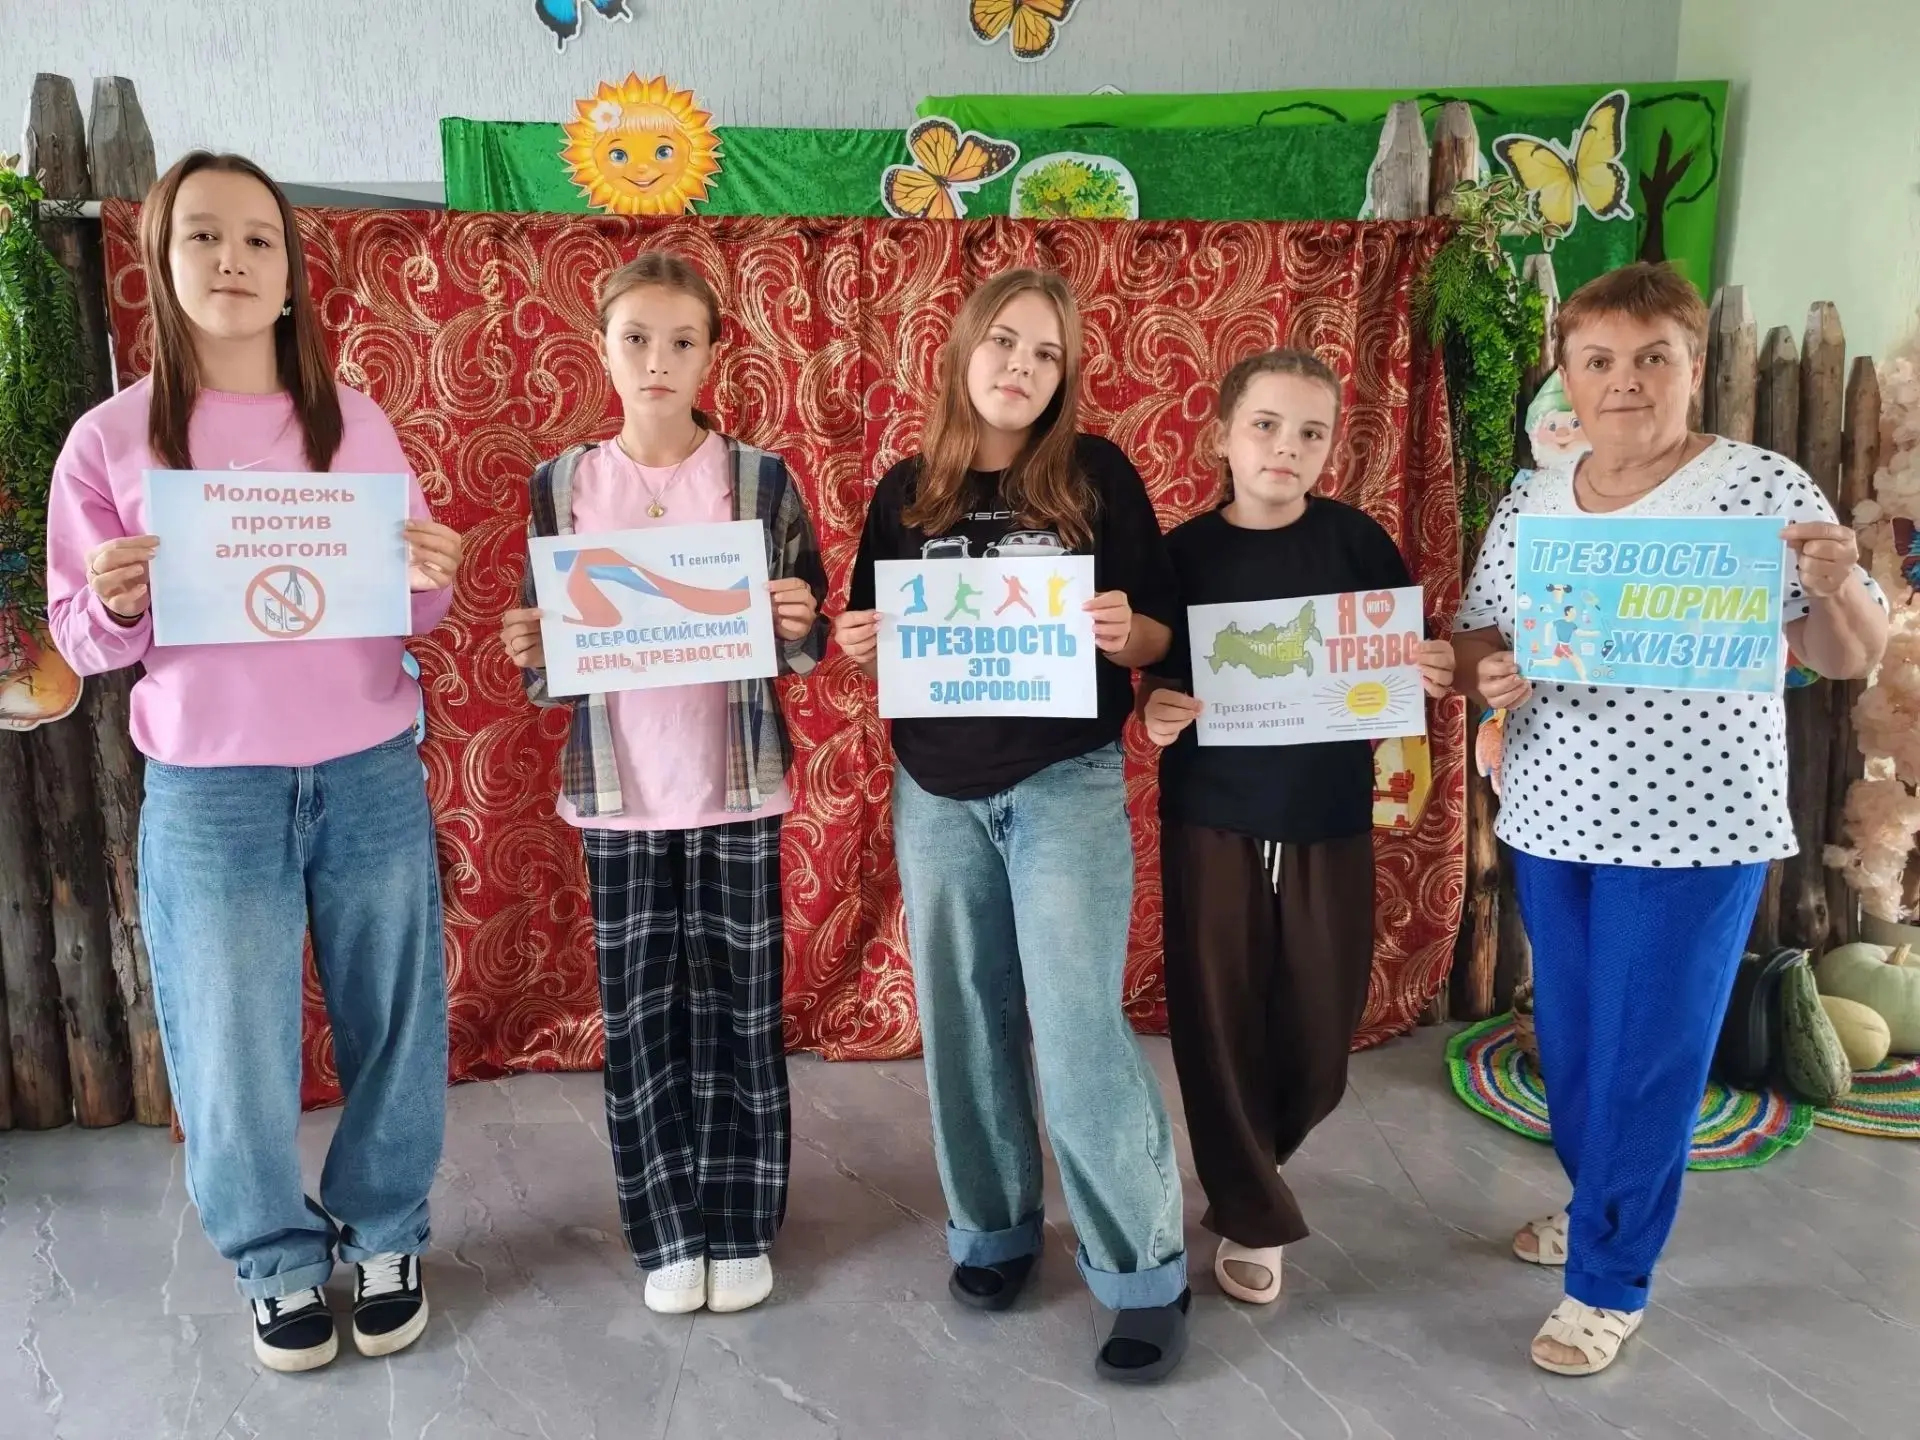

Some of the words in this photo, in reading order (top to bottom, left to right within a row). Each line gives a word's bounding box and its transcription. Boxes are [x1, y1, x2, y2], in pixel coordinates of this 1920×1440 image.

[203, 483, 355, 505] Молодежь
[231, 514, 332, 534] против
[215, 542, 348, 559] алкоголя
[669, 553, 685, 567] 11
[688, 552, 741, 566] сентября
[1530, 539, 1740, 578] ТРЕЗВОСТЬ
[1337, 592, 1357, 635] Я
[1366, 599, 1392, 614] ЖИТЬ
[1616, 583, 1770, 624] НОРМА
[575, 616, 749, 649] ВСЕРОССИЙСКИЙ
[896, 623, 1077, 659] ТРЕЗВОСТЬ
[576, 652, 632, 674] ДЕНЬ
[636, 642, 752, 667] ТРЕЗВОСТИ
[1325, 631, 1419, 674] ТРЕЗВО
[1604, 629, 1771, 670] ЖИЗНИ!
[968, 657, 1011, 677] ЭТО
[929, 680, 1051, 704] ЗДОРОВО!!!
[1211, 700, 1287, 716] Трезвость
[1208, 718, 1254, 732] норма
[1257, 716, 1305, 730] жизни
